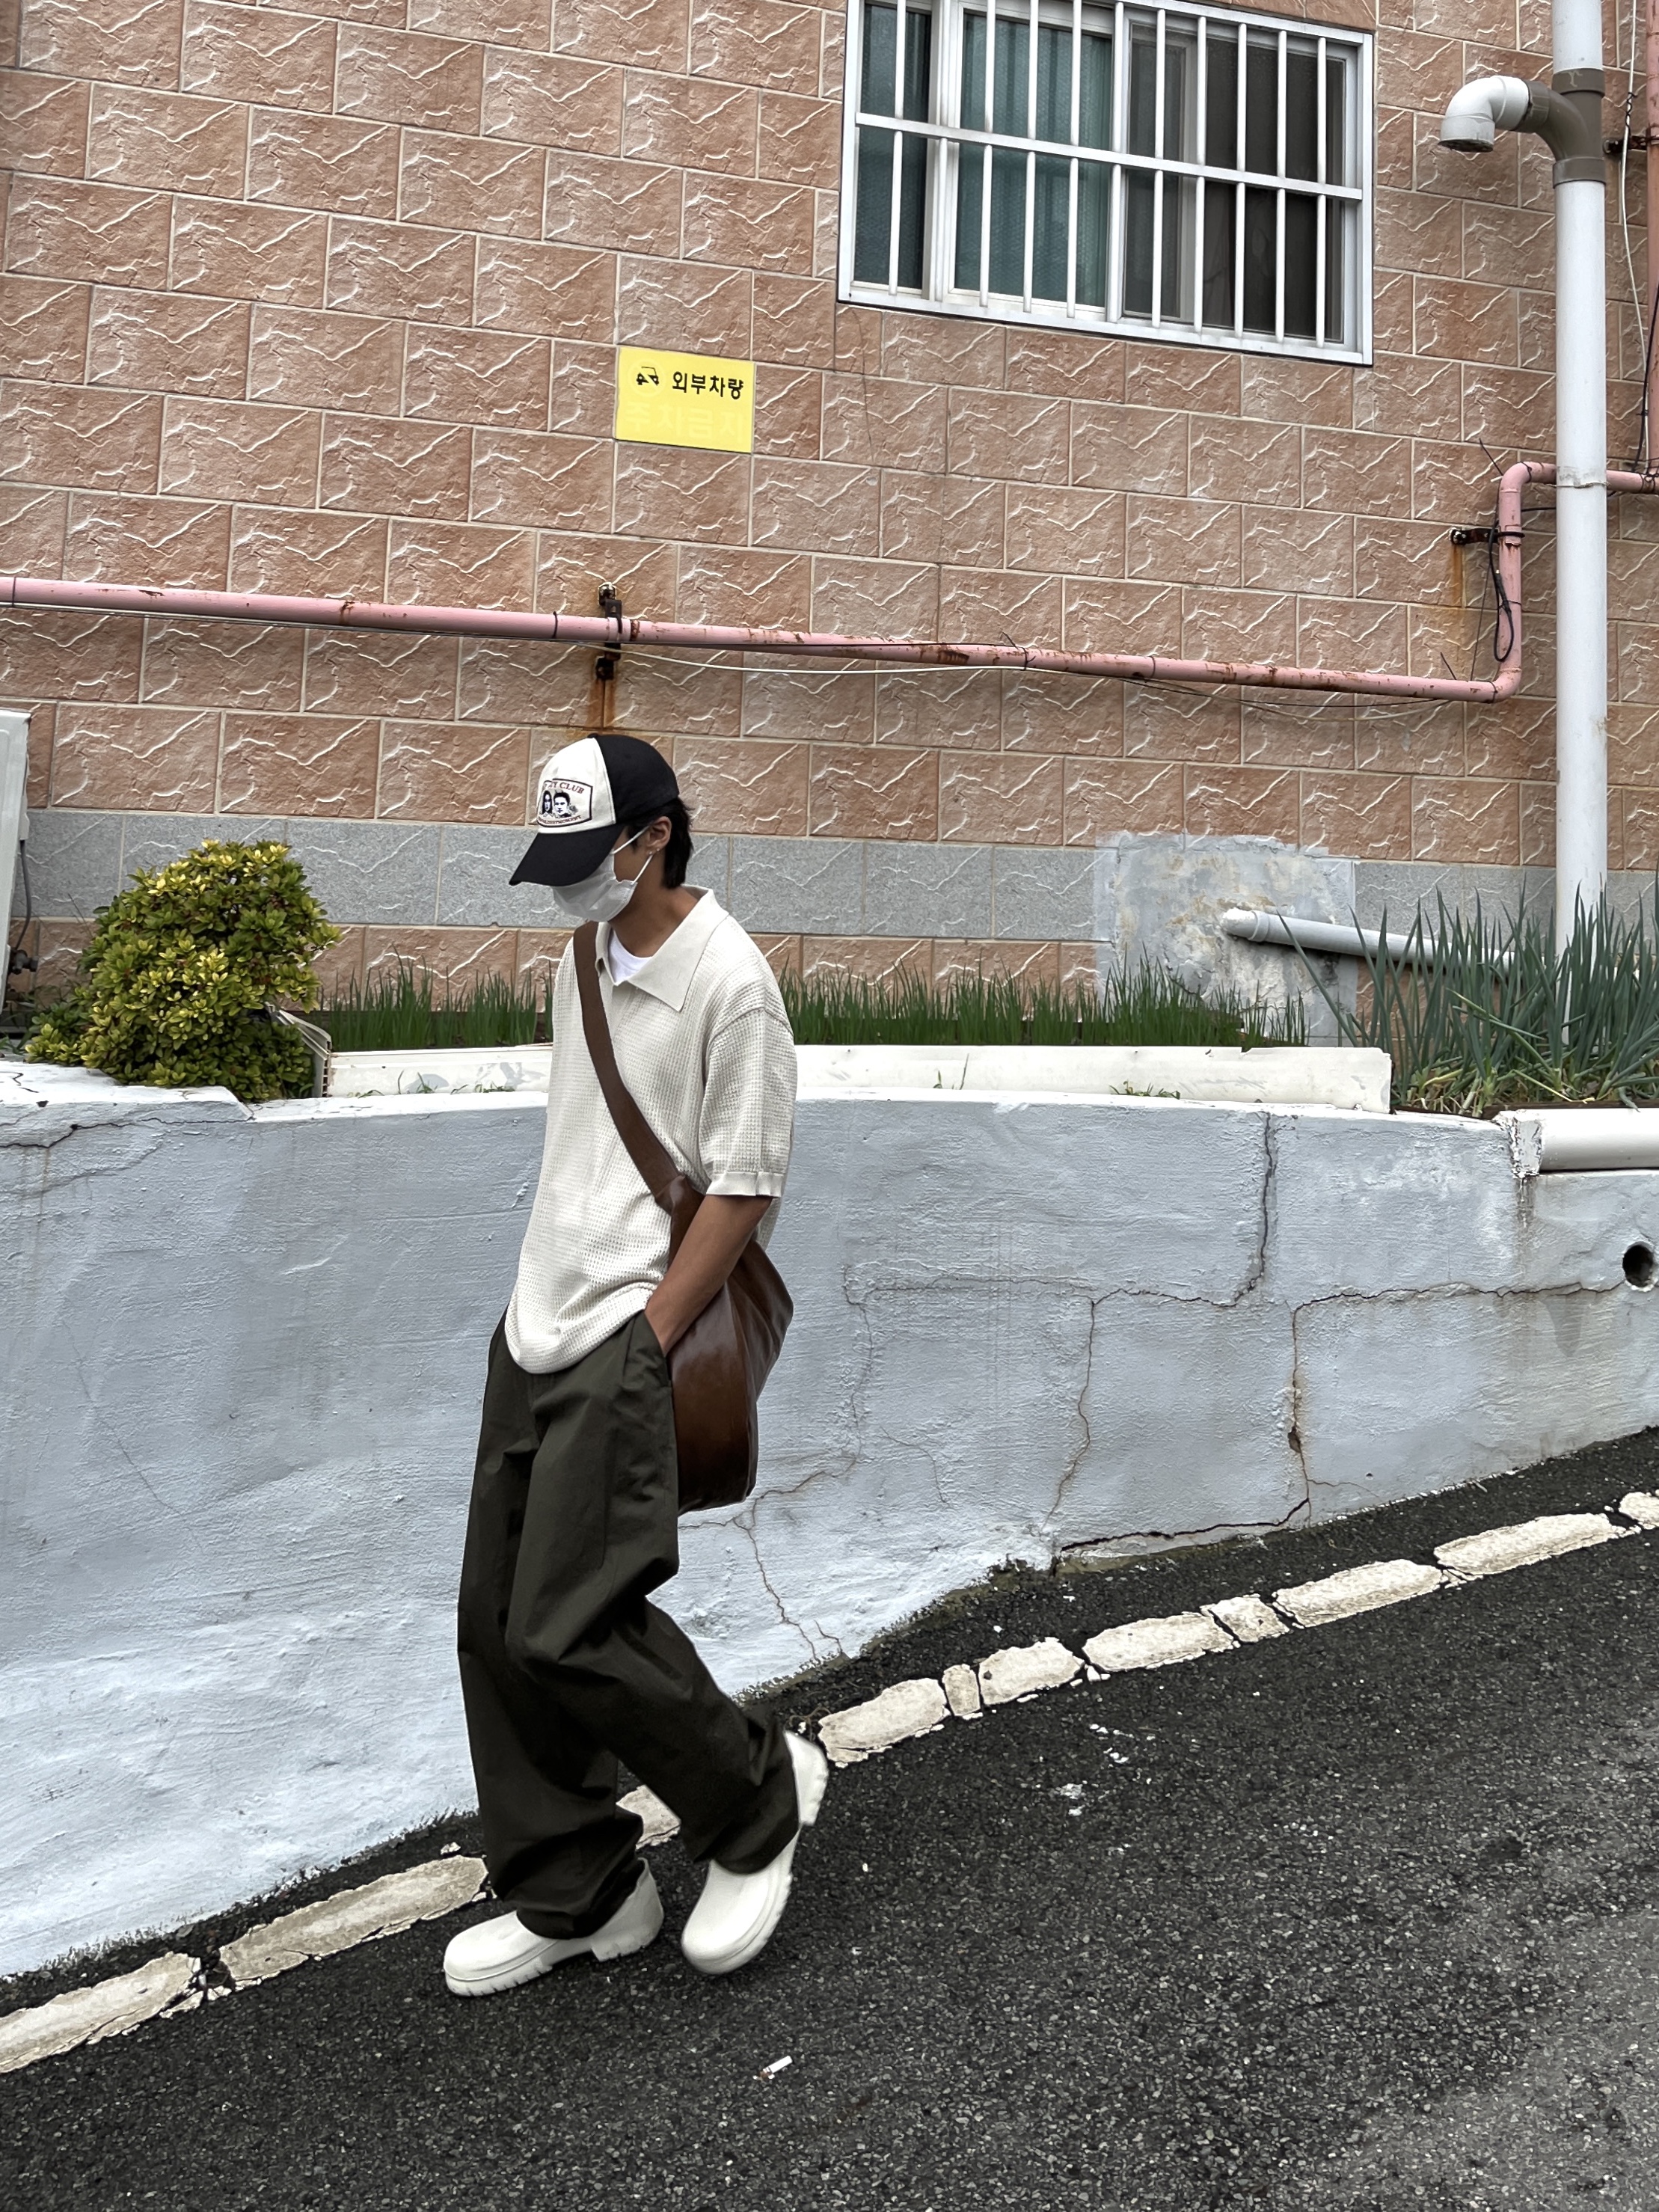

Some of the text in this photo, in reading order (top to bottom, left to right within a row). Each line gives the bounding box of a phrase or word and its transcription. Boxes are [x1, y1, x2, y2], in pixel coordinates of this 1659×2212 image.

[672, 371, 744, 399] 외부차량
[625, 401, 743, 443] 주차금지
[559, 782, 585, 794] CLUB
